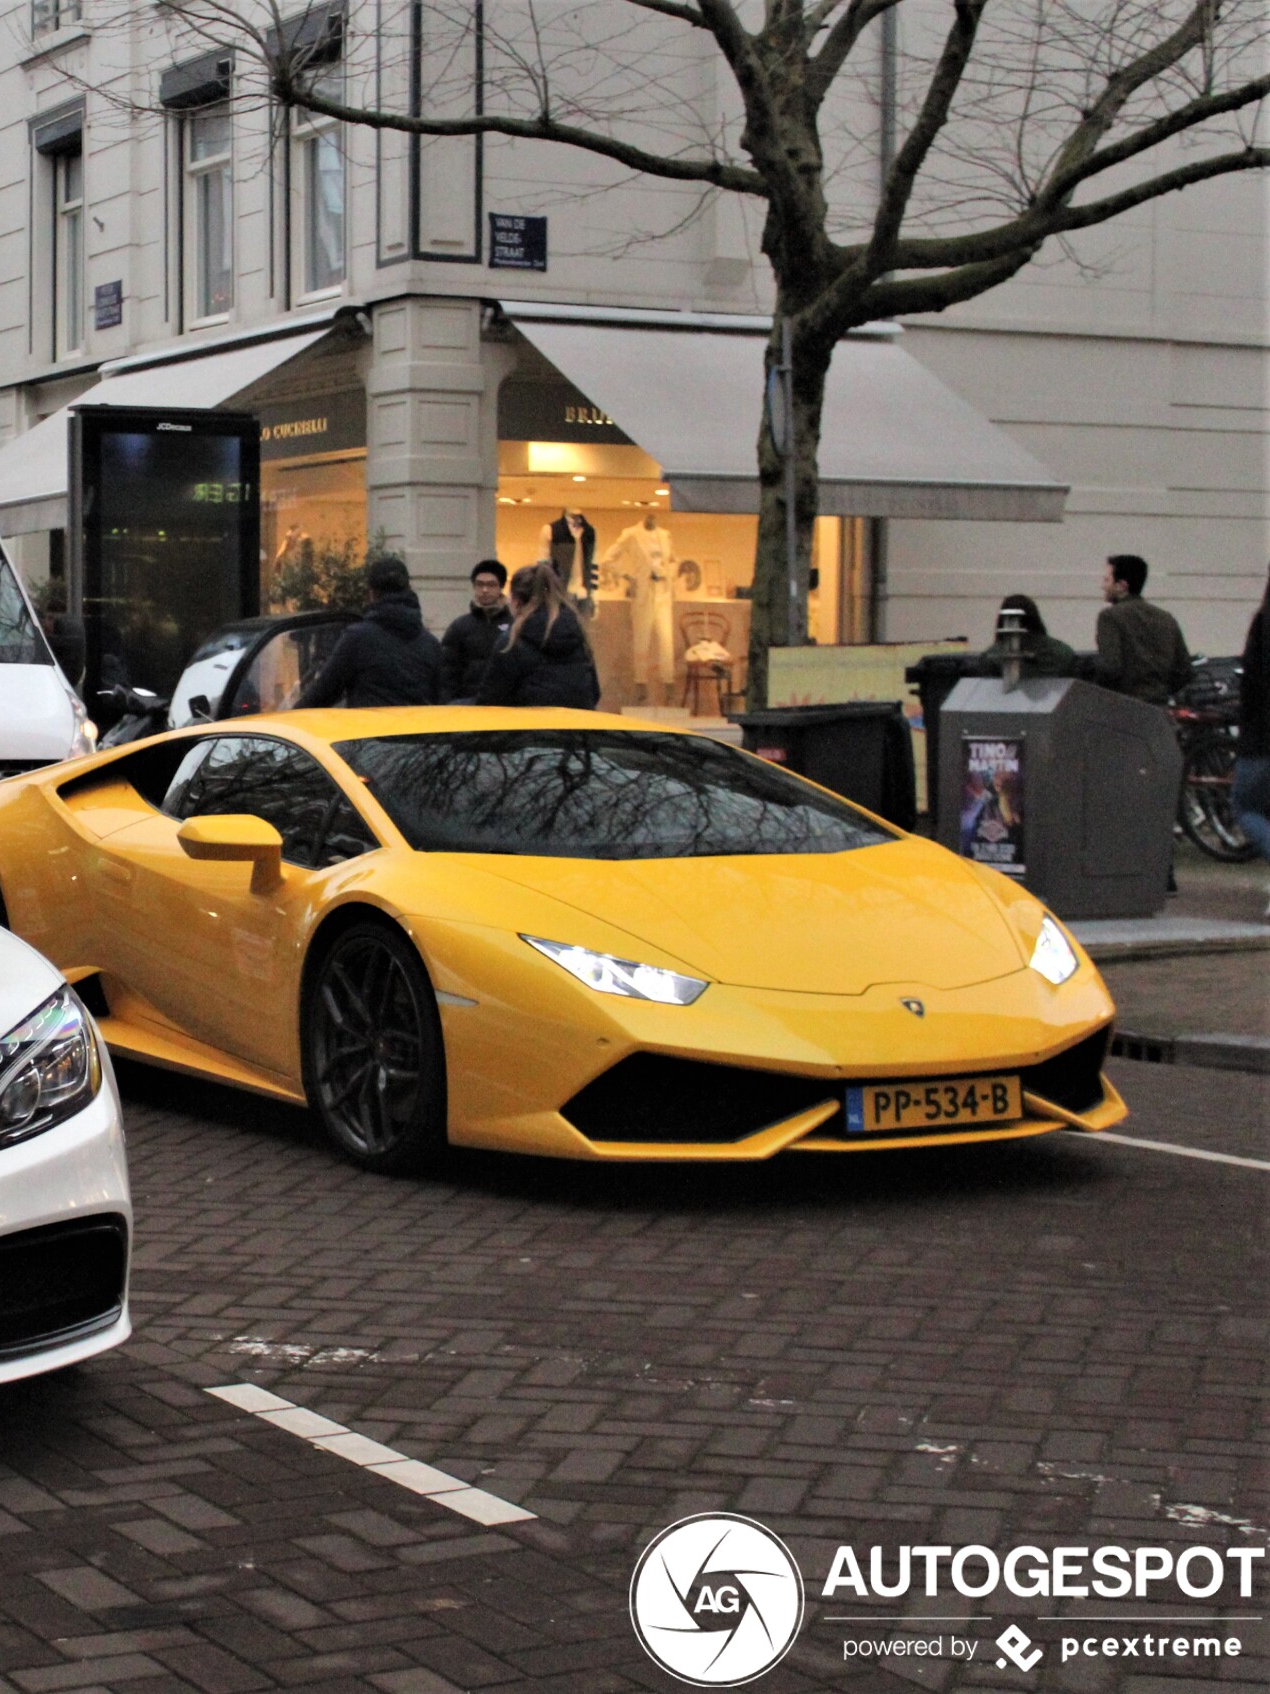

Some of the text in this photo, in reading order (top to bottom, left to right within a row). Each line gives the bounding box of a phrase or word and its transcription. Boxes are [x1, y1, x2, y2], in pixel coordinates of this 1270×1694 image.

[495, 246, 525, 258] STRAAT
[565, 405, 614, 425] BRU
[970, 743, 1006, 759] TINO
[874, 1082, 1010, 1124] PP-534-B
